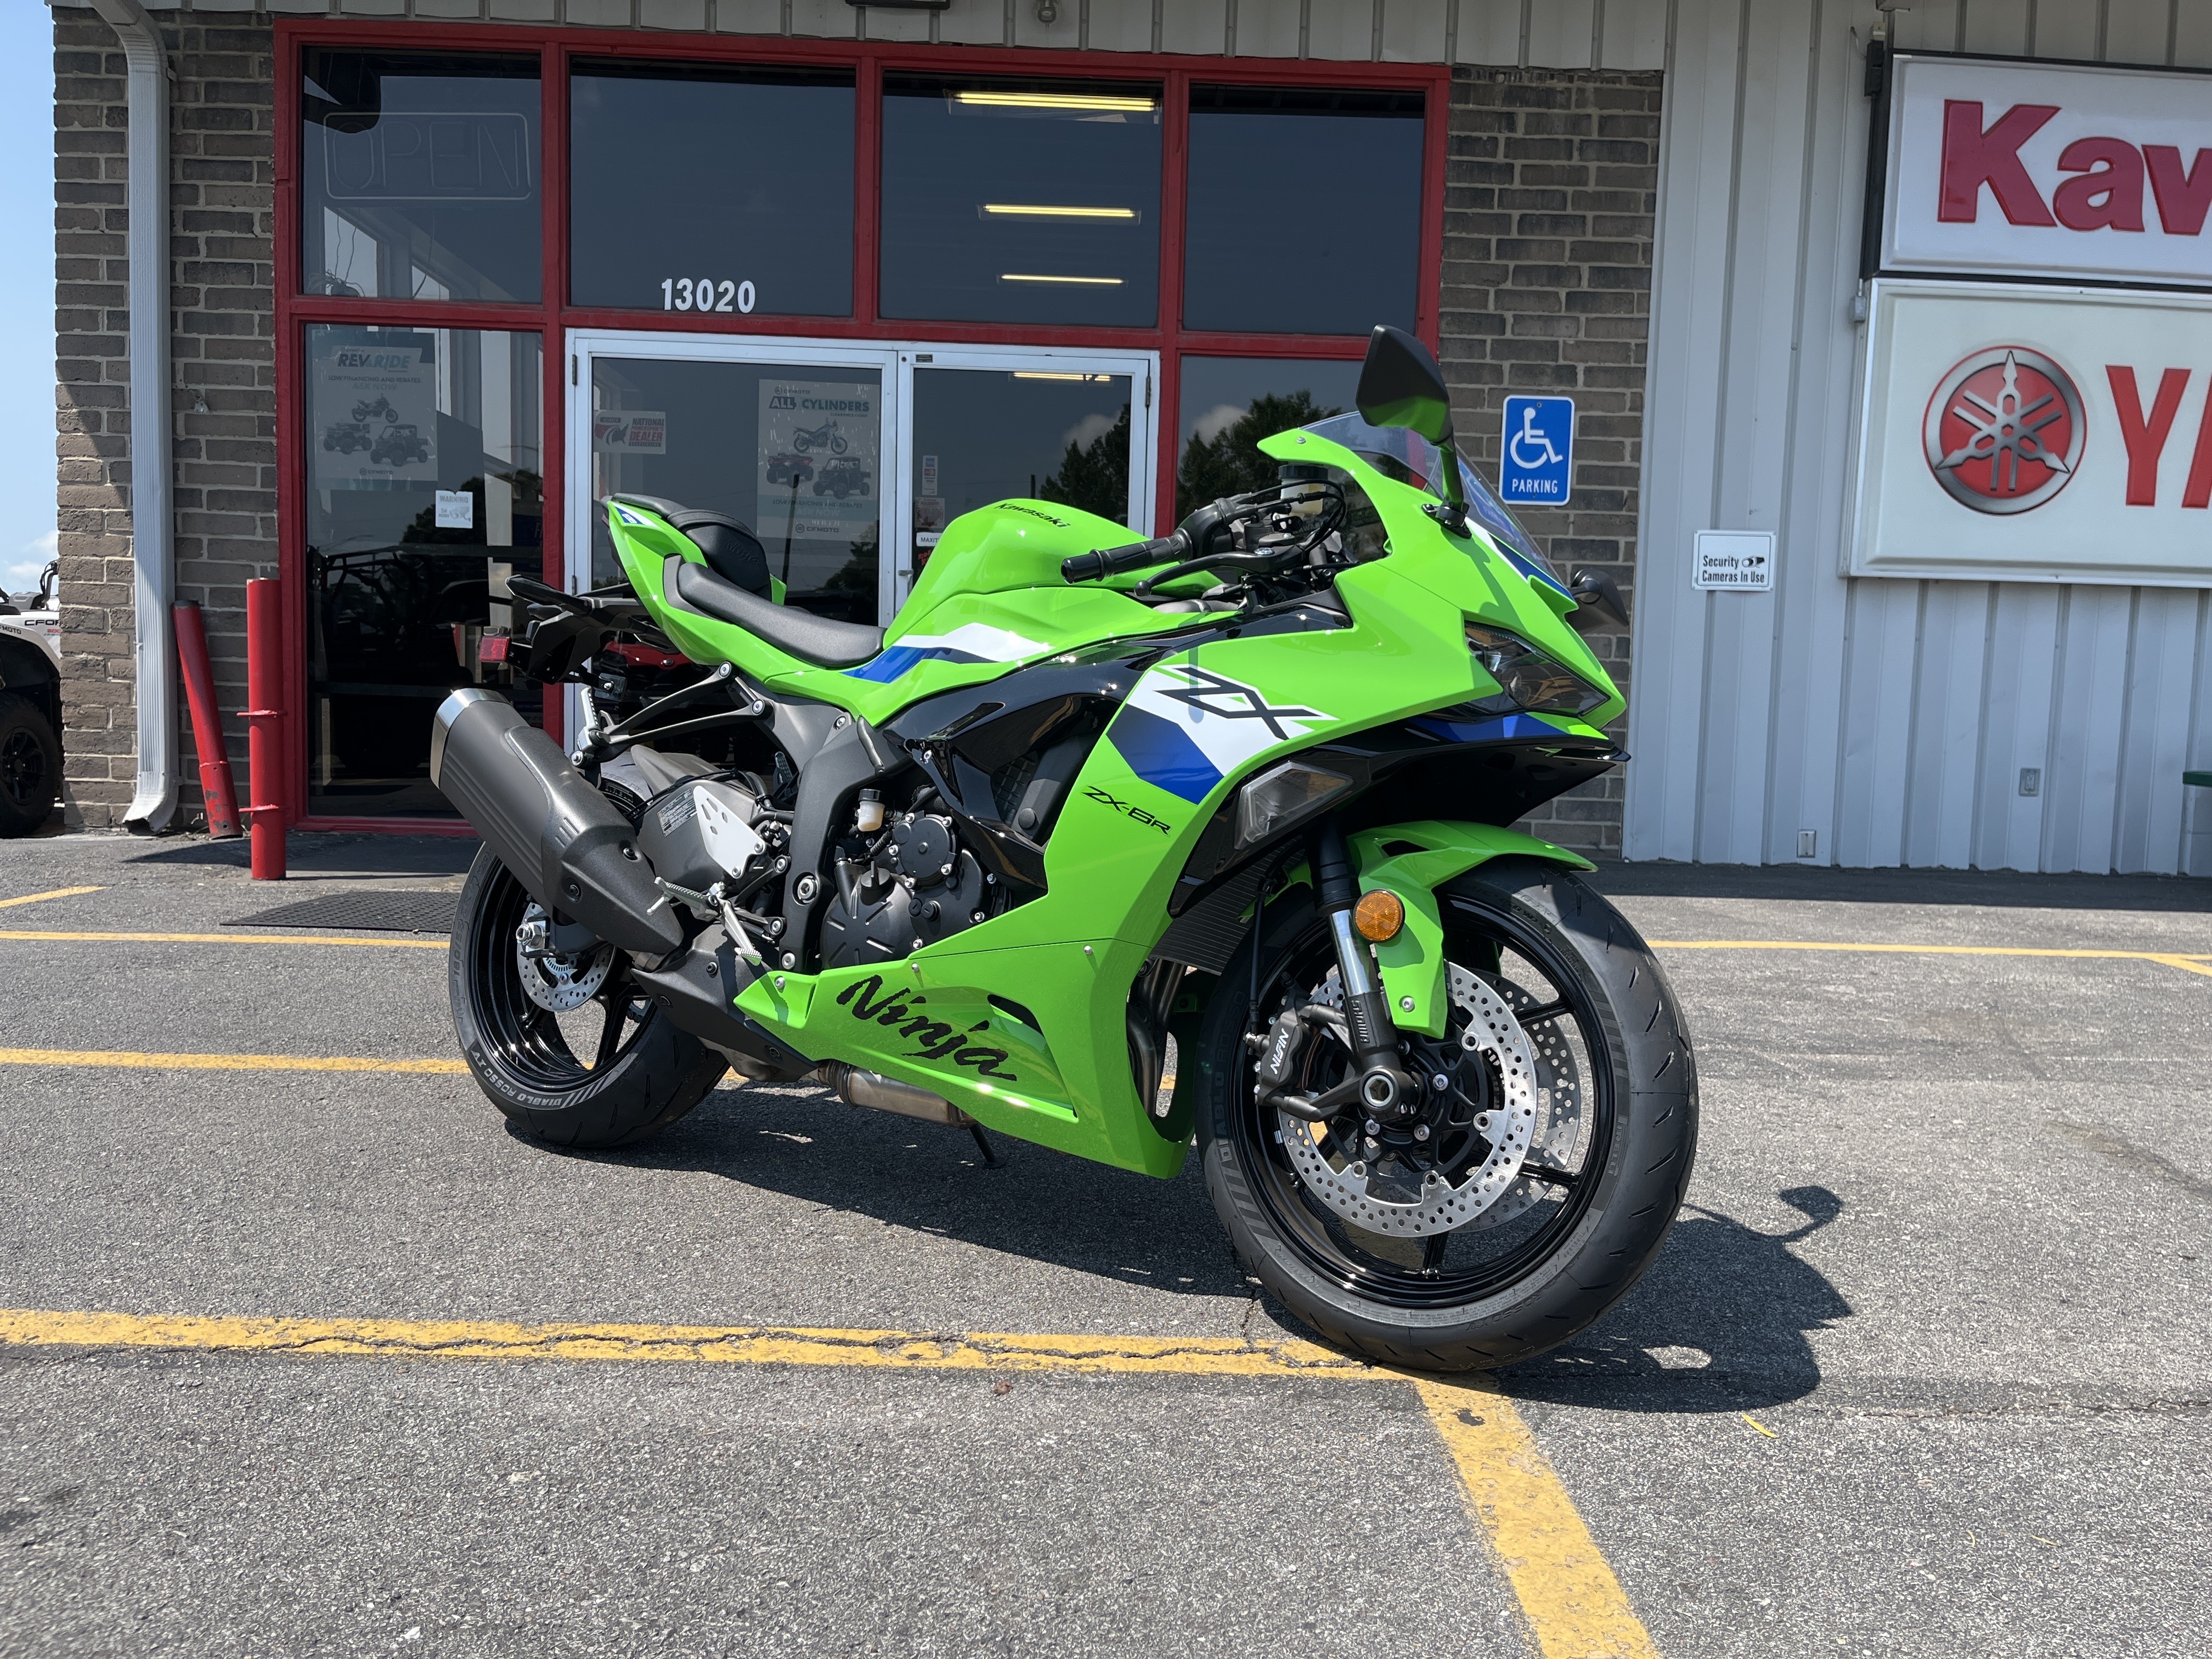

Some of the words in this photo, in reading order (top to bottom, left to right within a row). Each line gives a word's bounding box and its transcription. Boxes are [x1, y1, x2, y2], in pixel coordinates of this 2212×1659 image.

[332, 120, 519, 190] OPEN
[661, 278, 755, 313] 13020
[770, 396, 795, 410] ALL
[802, 399, 869, 411] CYLINDERS
[629, 431, 664, 441] DEALER
[1512, 478, 1558, 494] PARKING
[440, 495, 469, 504] WARNING
[994, 503, 1071, 528] Kawasaki
[1703, 555, 1739, 569] Security
[1702, 569, 1738, 582] Cameras
[1741, 571, 1748, 583] In
[1751, 571, 1764, 583] Use
[0, 625, 21, 634] MOTO
[1152, 667, 1323, 741] ZX
[602, 772, 628, 783] OSSO
[1081, 786, 1171, 835] ZX-6R
[836, 974, 1017, 1081] Ninja
[1351, 1000, 1370, 1043] SHOWA
[471, 1049, 487, 1068] IV
[1270, 1028, 1289, 1075] NISSIN
[484, 1068, 518, 1098] ROSSO
[517, 1092, 563, 1108] DIABLO
[1212, 1071, 1233, 1162] DIABLO
[1607, 1116, 1628, 1176] PIRELLI
